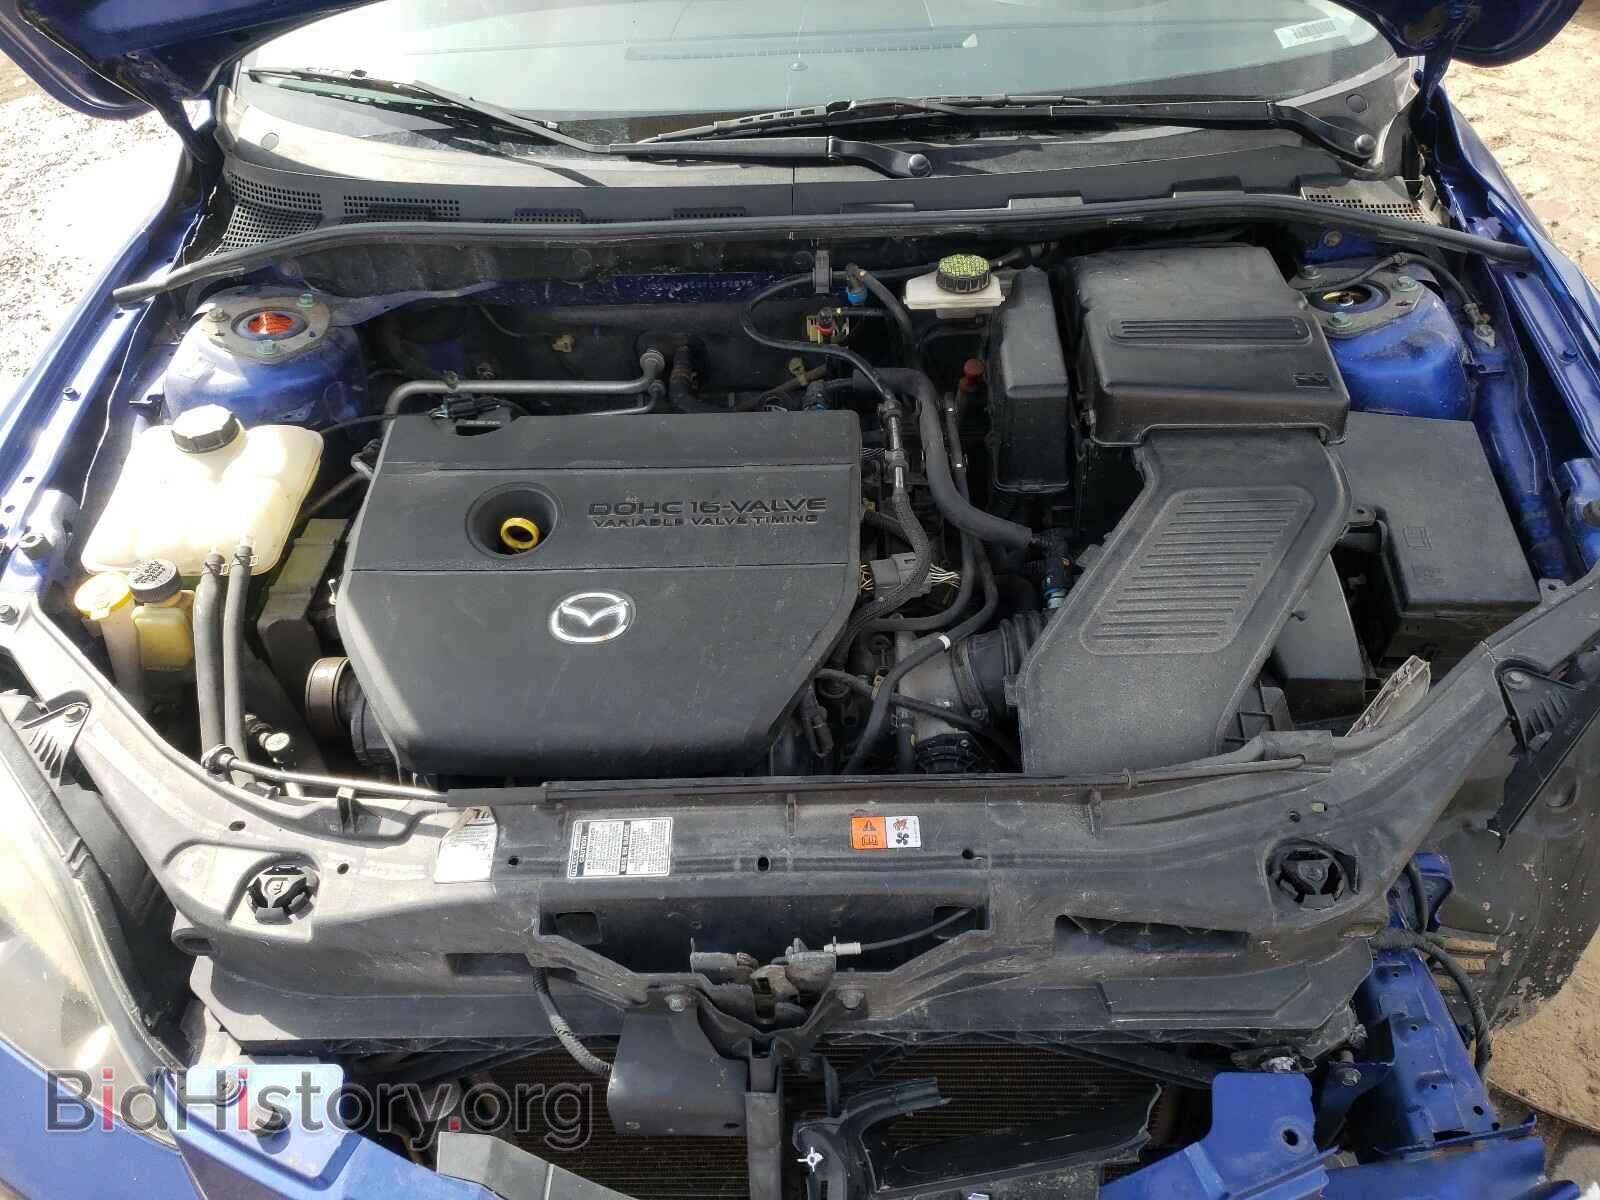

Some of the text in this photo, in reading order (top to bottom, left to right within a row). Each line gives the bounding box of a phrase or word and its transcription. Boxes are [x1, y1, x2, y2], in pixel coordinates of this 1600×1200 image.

[589, 497, 827, 516] DOHC 16-VALVE
[592, 513, 818, 528] VARIABLE VALVE TIMING
